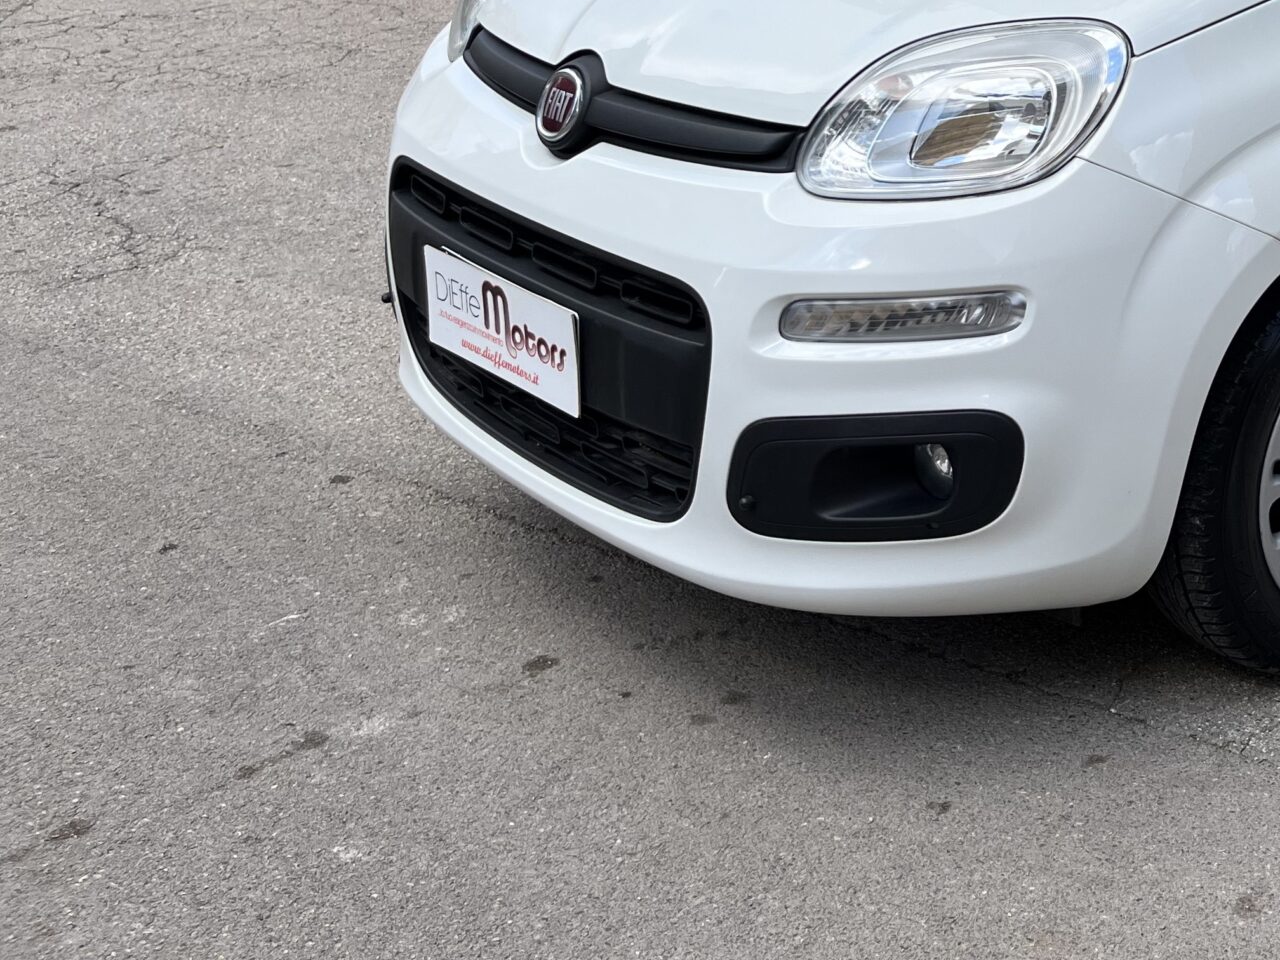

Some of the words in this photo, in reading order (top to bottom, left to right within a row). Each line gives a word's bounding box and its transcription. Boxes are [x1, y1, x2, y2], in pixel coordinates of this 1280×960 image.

[544, 87, 573, 123] FIAT
[435, 271, 481, 318] DiEffe
[481, 280, 567, 372] Motors
